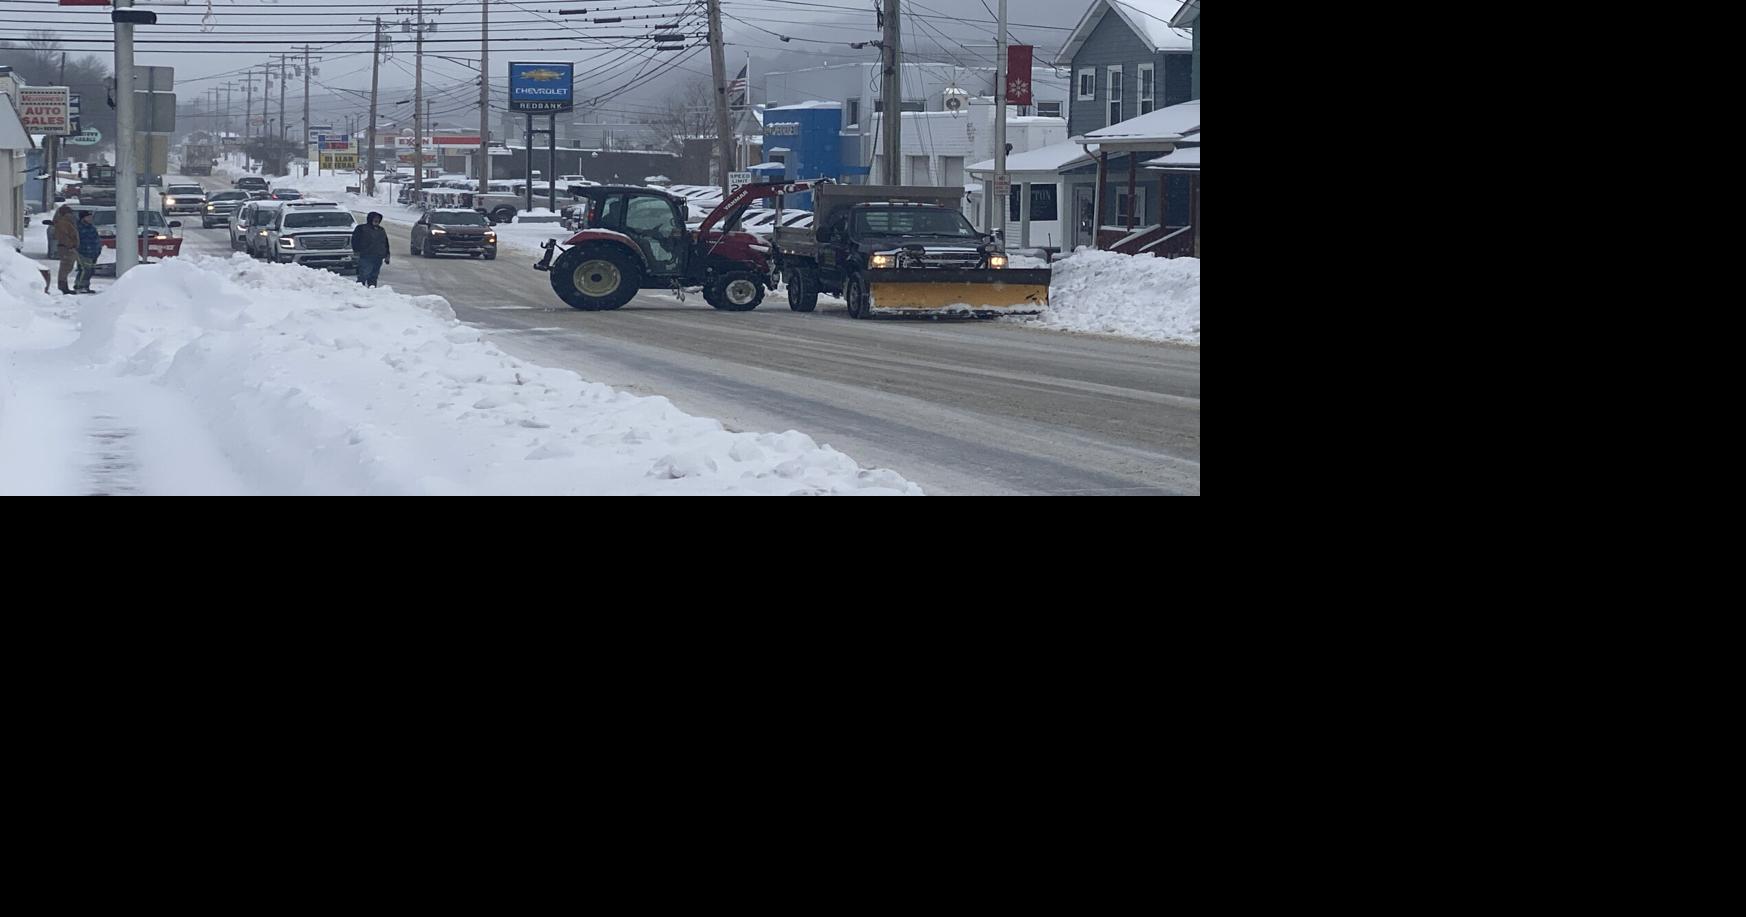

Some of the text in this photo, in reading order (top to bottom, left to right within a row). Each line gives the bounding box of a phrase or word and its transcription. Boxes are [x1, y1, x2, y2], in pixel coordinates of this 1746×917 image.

[515, 87, 568, 95] CHEVROLET
[25, 107, 61, 115] AUTO
[23, 116, 65, 125] SALES
[724, 190, 749, 210] YANMAR
